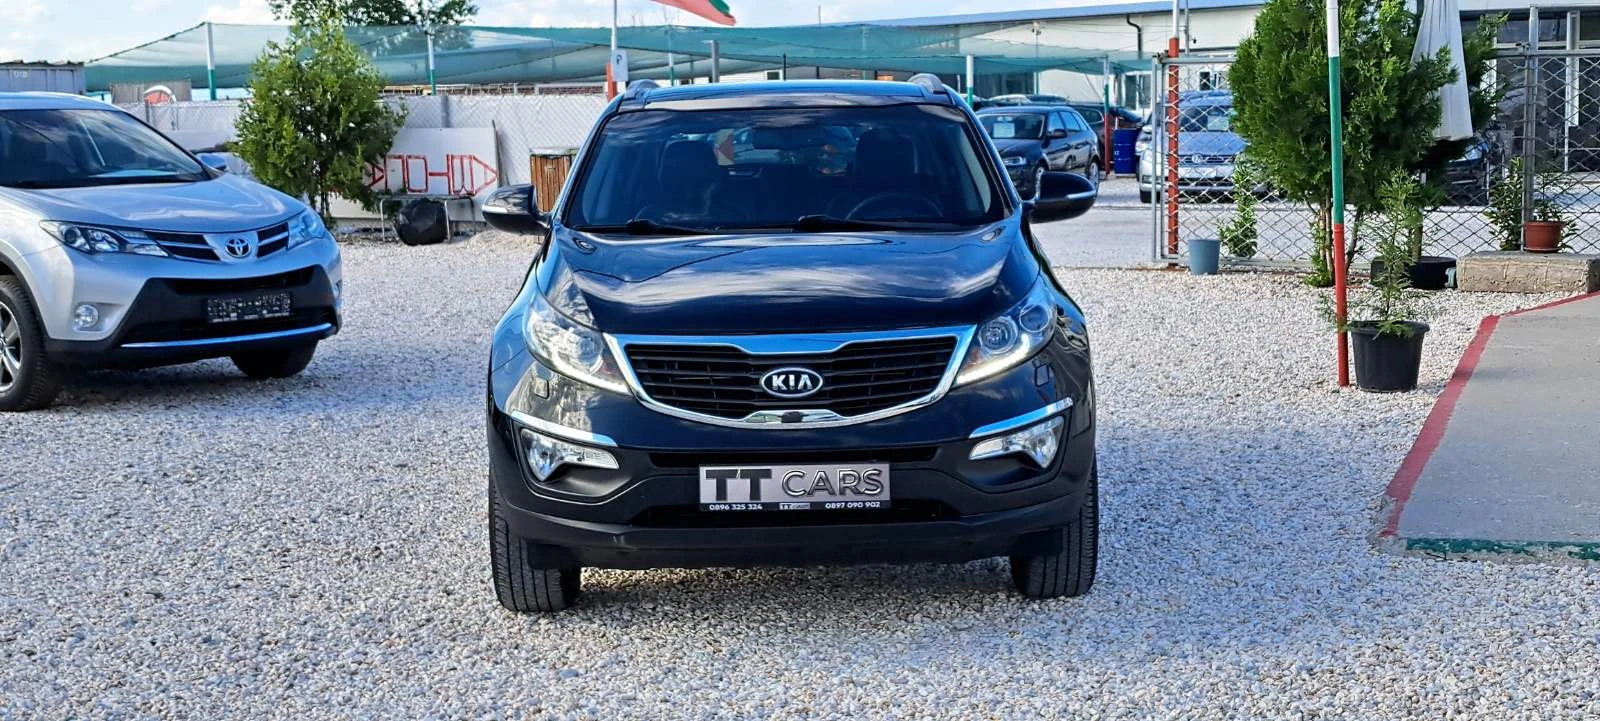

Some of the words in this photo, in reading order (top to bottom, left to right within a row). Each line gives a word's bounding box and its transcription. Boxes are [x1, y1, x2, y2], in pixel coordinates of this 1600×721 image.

[772, 374, 813, 391] KIA
[706, 468, 772, 501] TT
[782, 469, 884, 498] CARS
[709, 503, 730, 511] 0896
